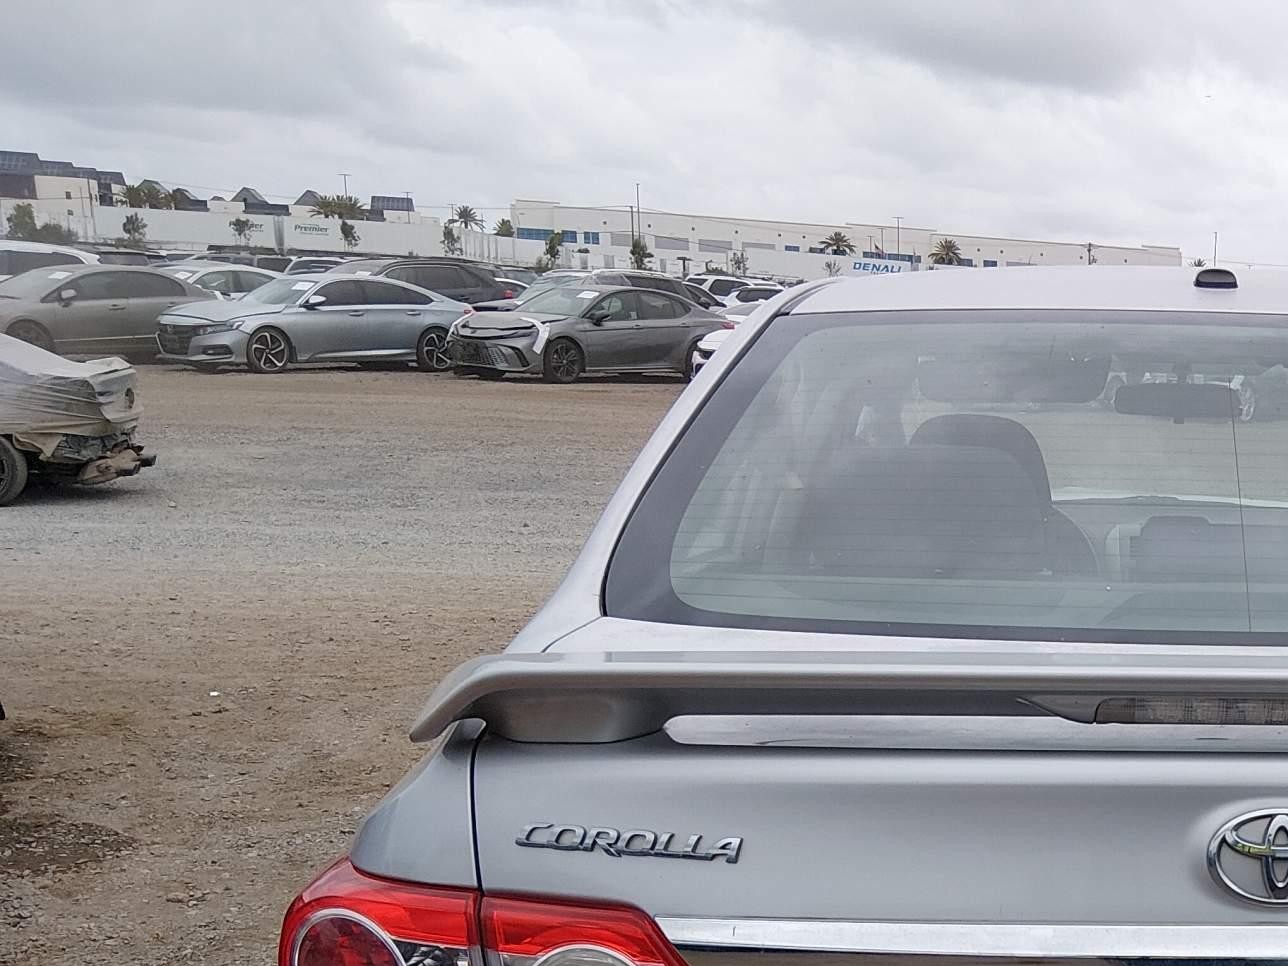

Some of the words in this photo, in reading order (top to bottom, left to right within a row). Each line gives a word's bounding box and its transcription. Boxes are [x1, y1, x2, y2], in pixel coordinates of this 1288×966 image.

[294, 223, 329, 233] Premier
[853, 261, 902, 273] DENALI
[515, 821, 744, 865] COROLLA
